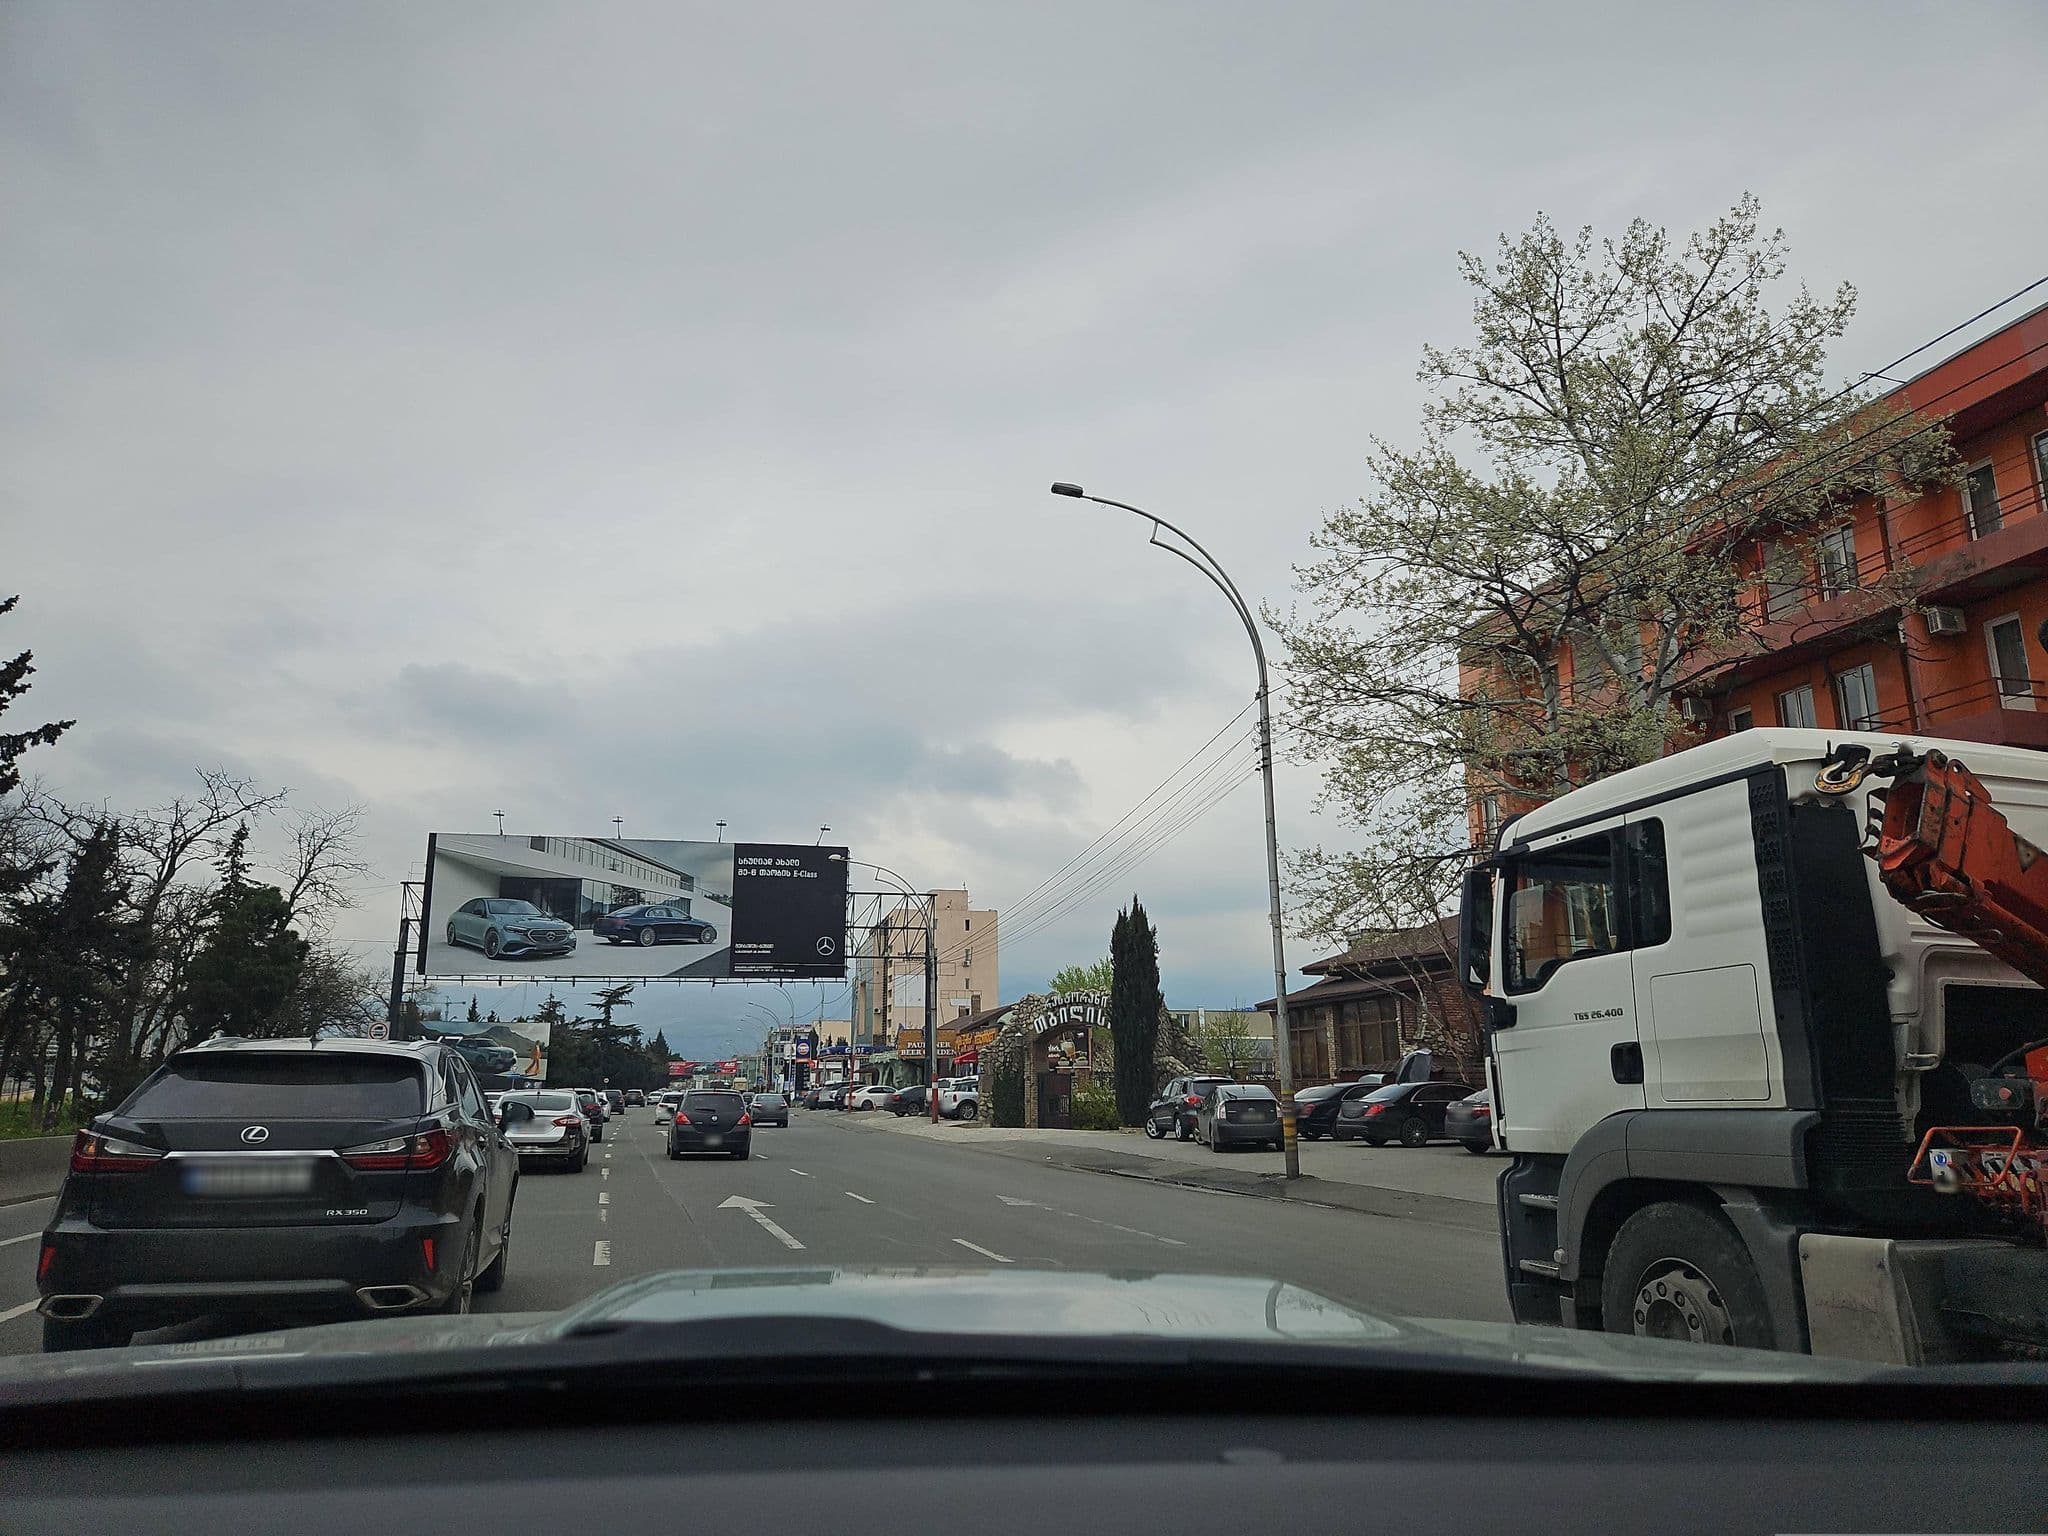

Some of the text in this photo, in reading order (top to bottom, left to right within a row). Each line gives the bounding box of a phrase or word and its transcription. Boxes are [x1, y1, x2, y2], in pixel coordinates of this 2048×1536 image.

[793, 870, 818, 878] E-Class
[1591, 1007, 1624, 1019] 26.400
[1034, 1005, 1111, 1034] თბილის
